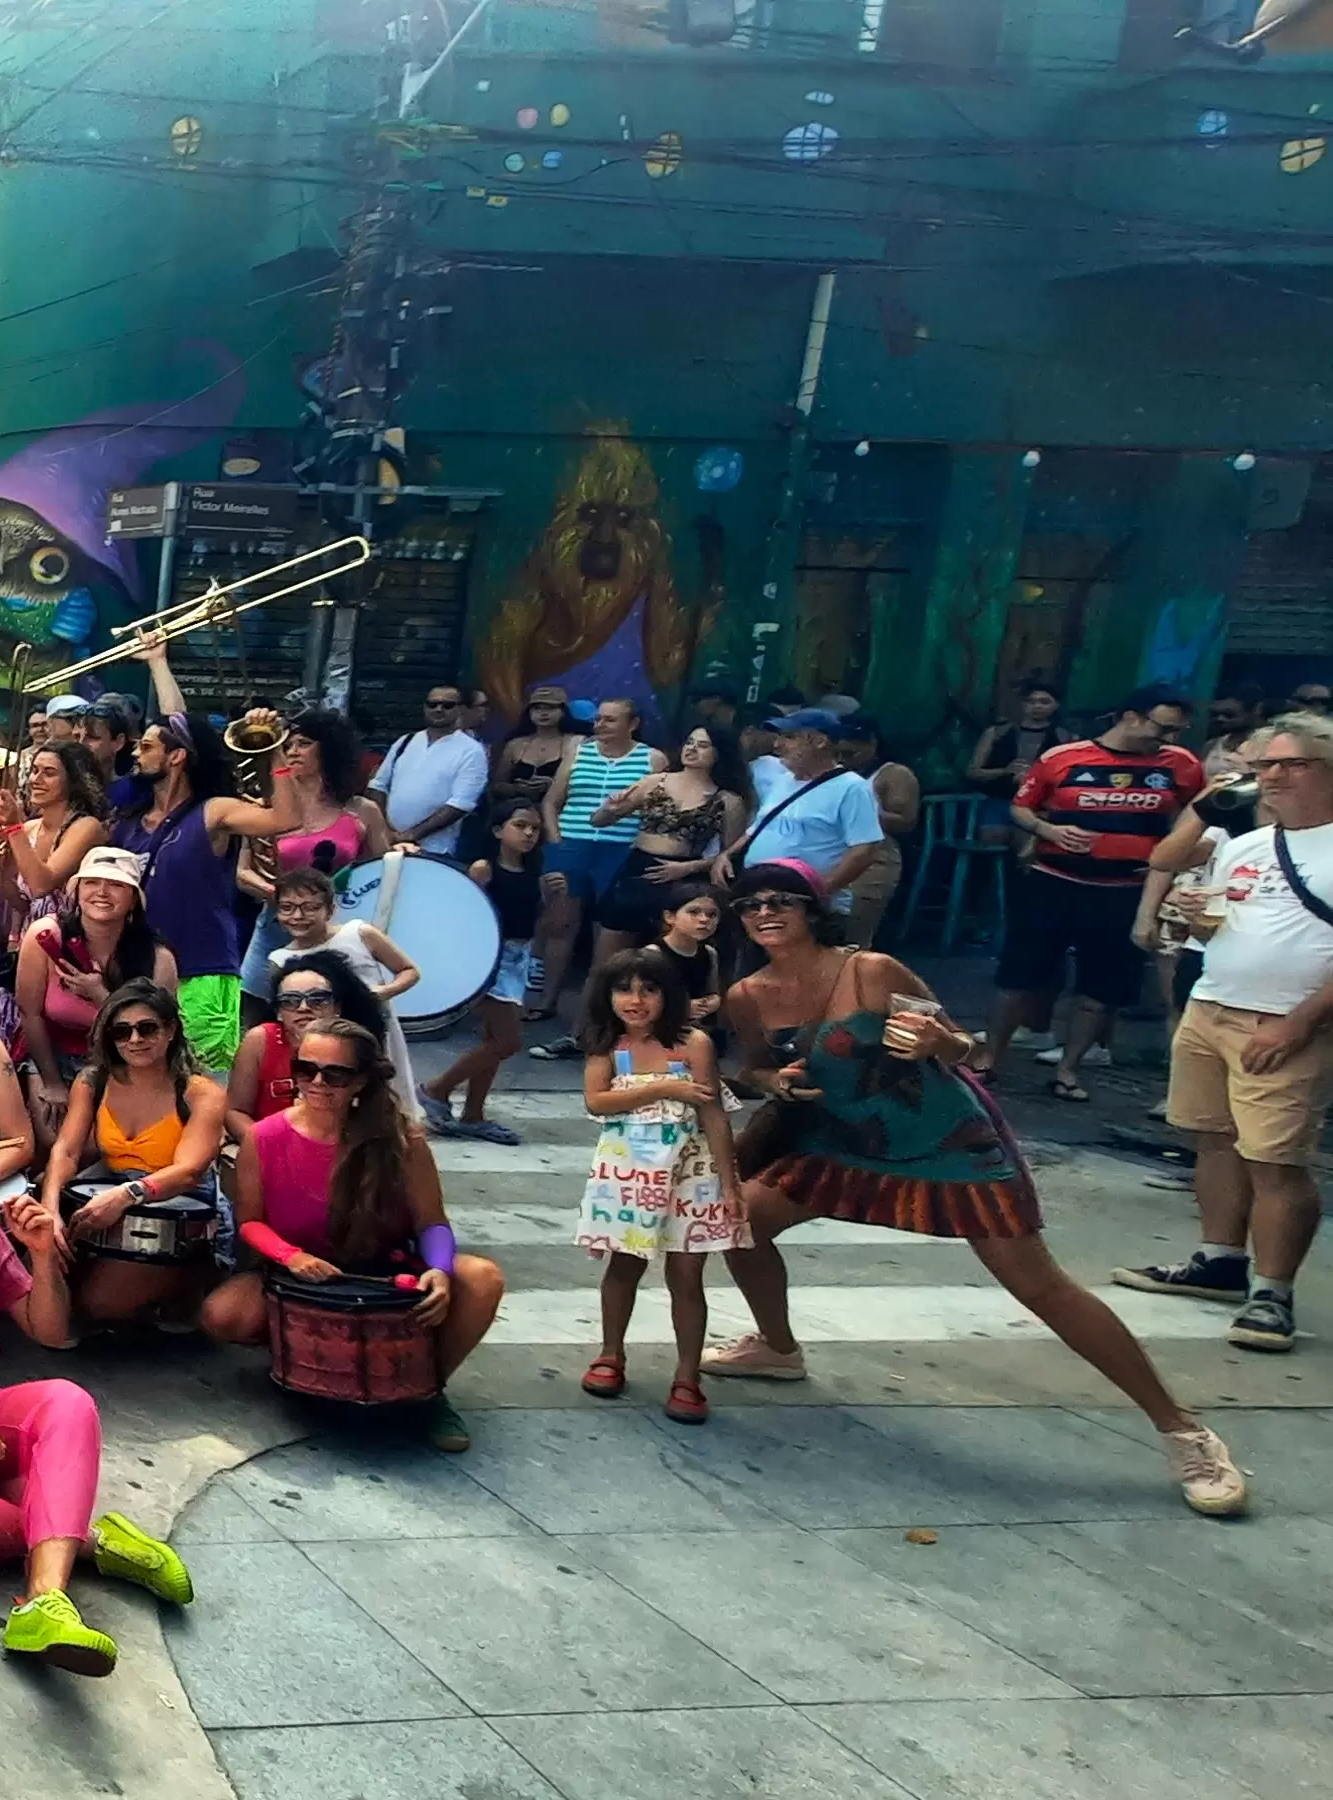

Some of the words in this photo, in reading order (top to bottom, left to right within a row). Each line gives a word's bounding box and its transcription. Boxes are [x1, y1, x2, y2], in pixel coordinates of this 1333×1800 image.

[193, 487, 215, 498] Rua
[192, 501, 221, 512] Victor
[223, 502, 270, 516] Meirelles
